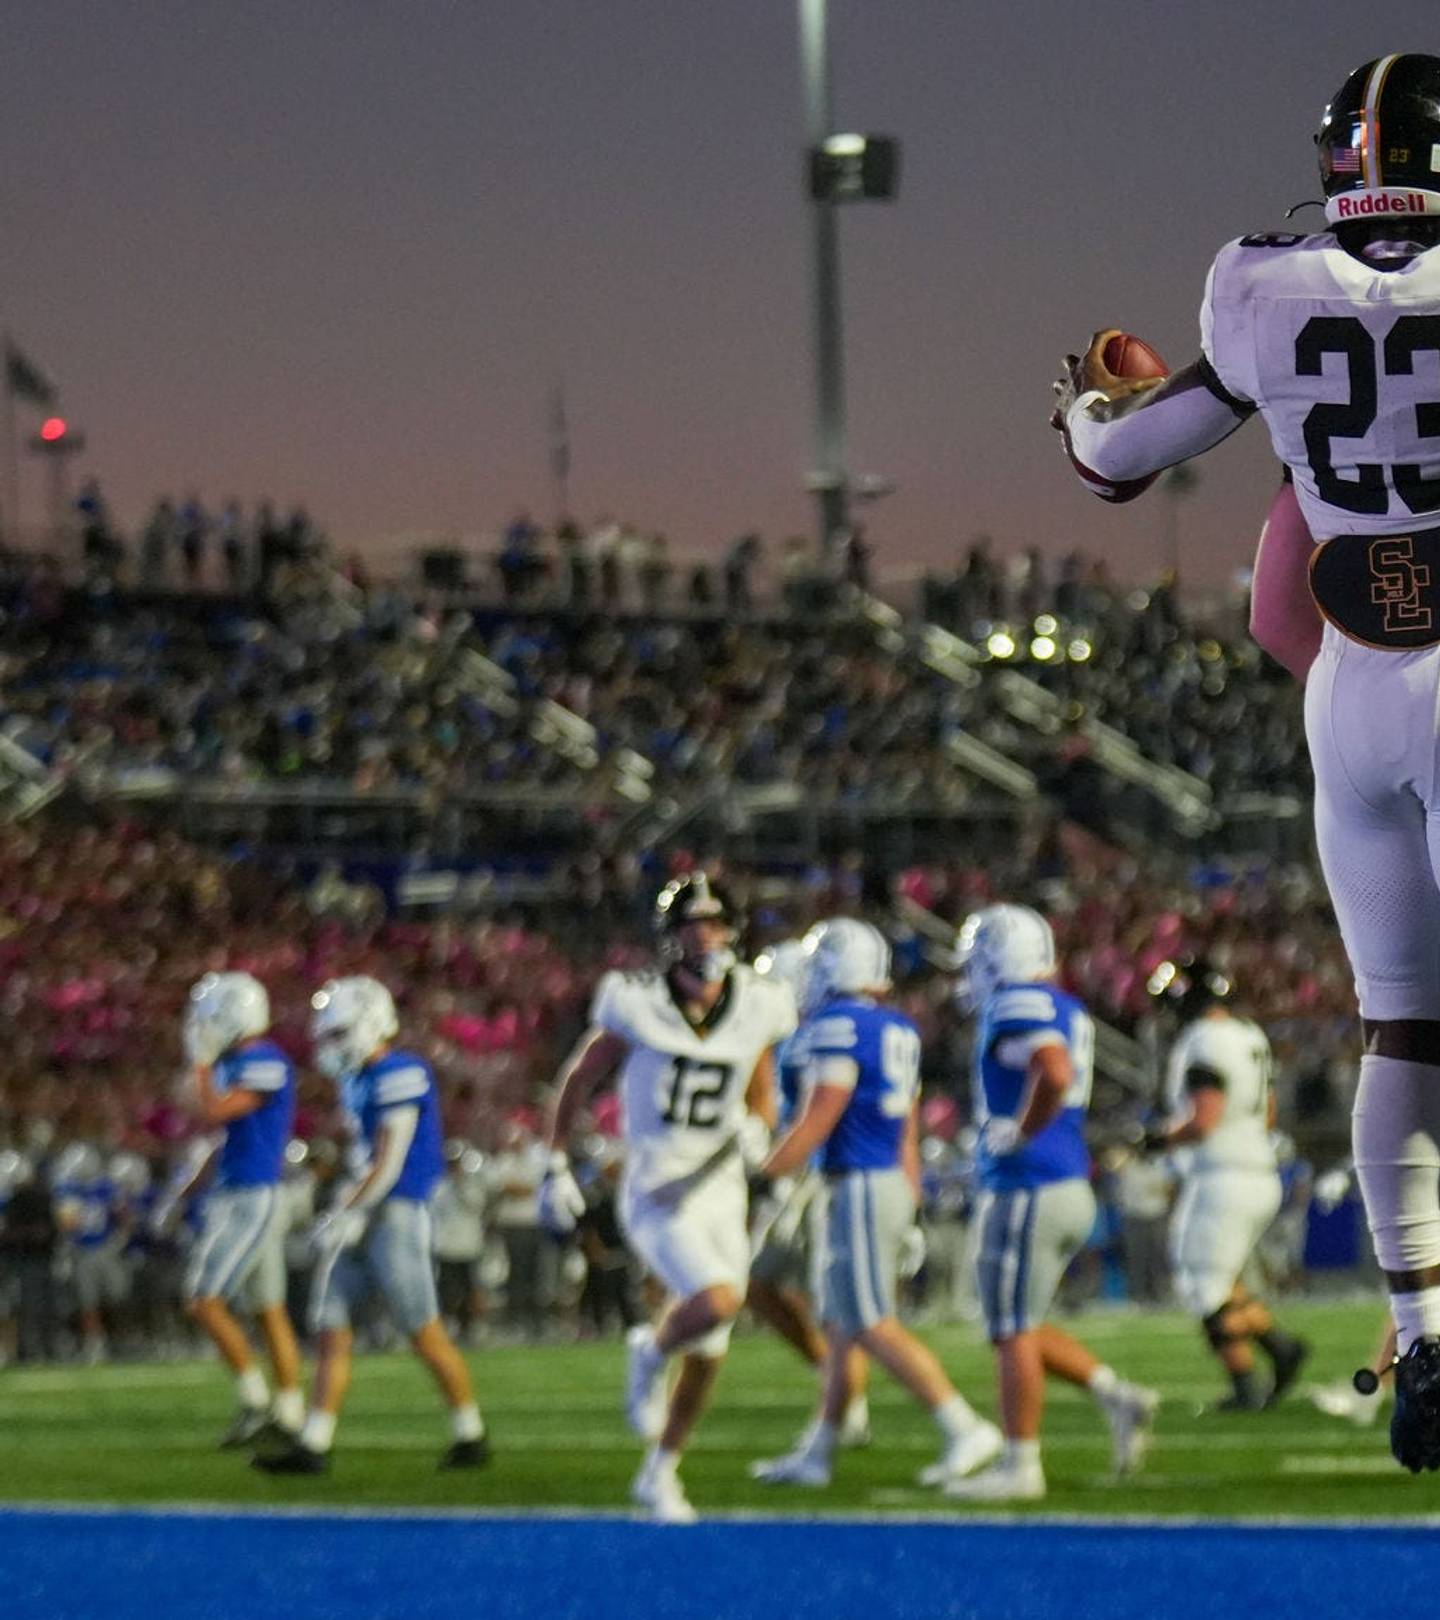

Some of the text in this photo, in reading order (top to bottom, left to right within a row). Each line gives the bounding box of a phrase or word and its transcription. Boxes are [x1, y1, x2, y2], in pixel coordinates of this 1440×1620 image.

[1388, 148, 1410, 162] 23
[1338, 193, 1425, 217] Riddell
[662, 1055, 735, 1128] 12
